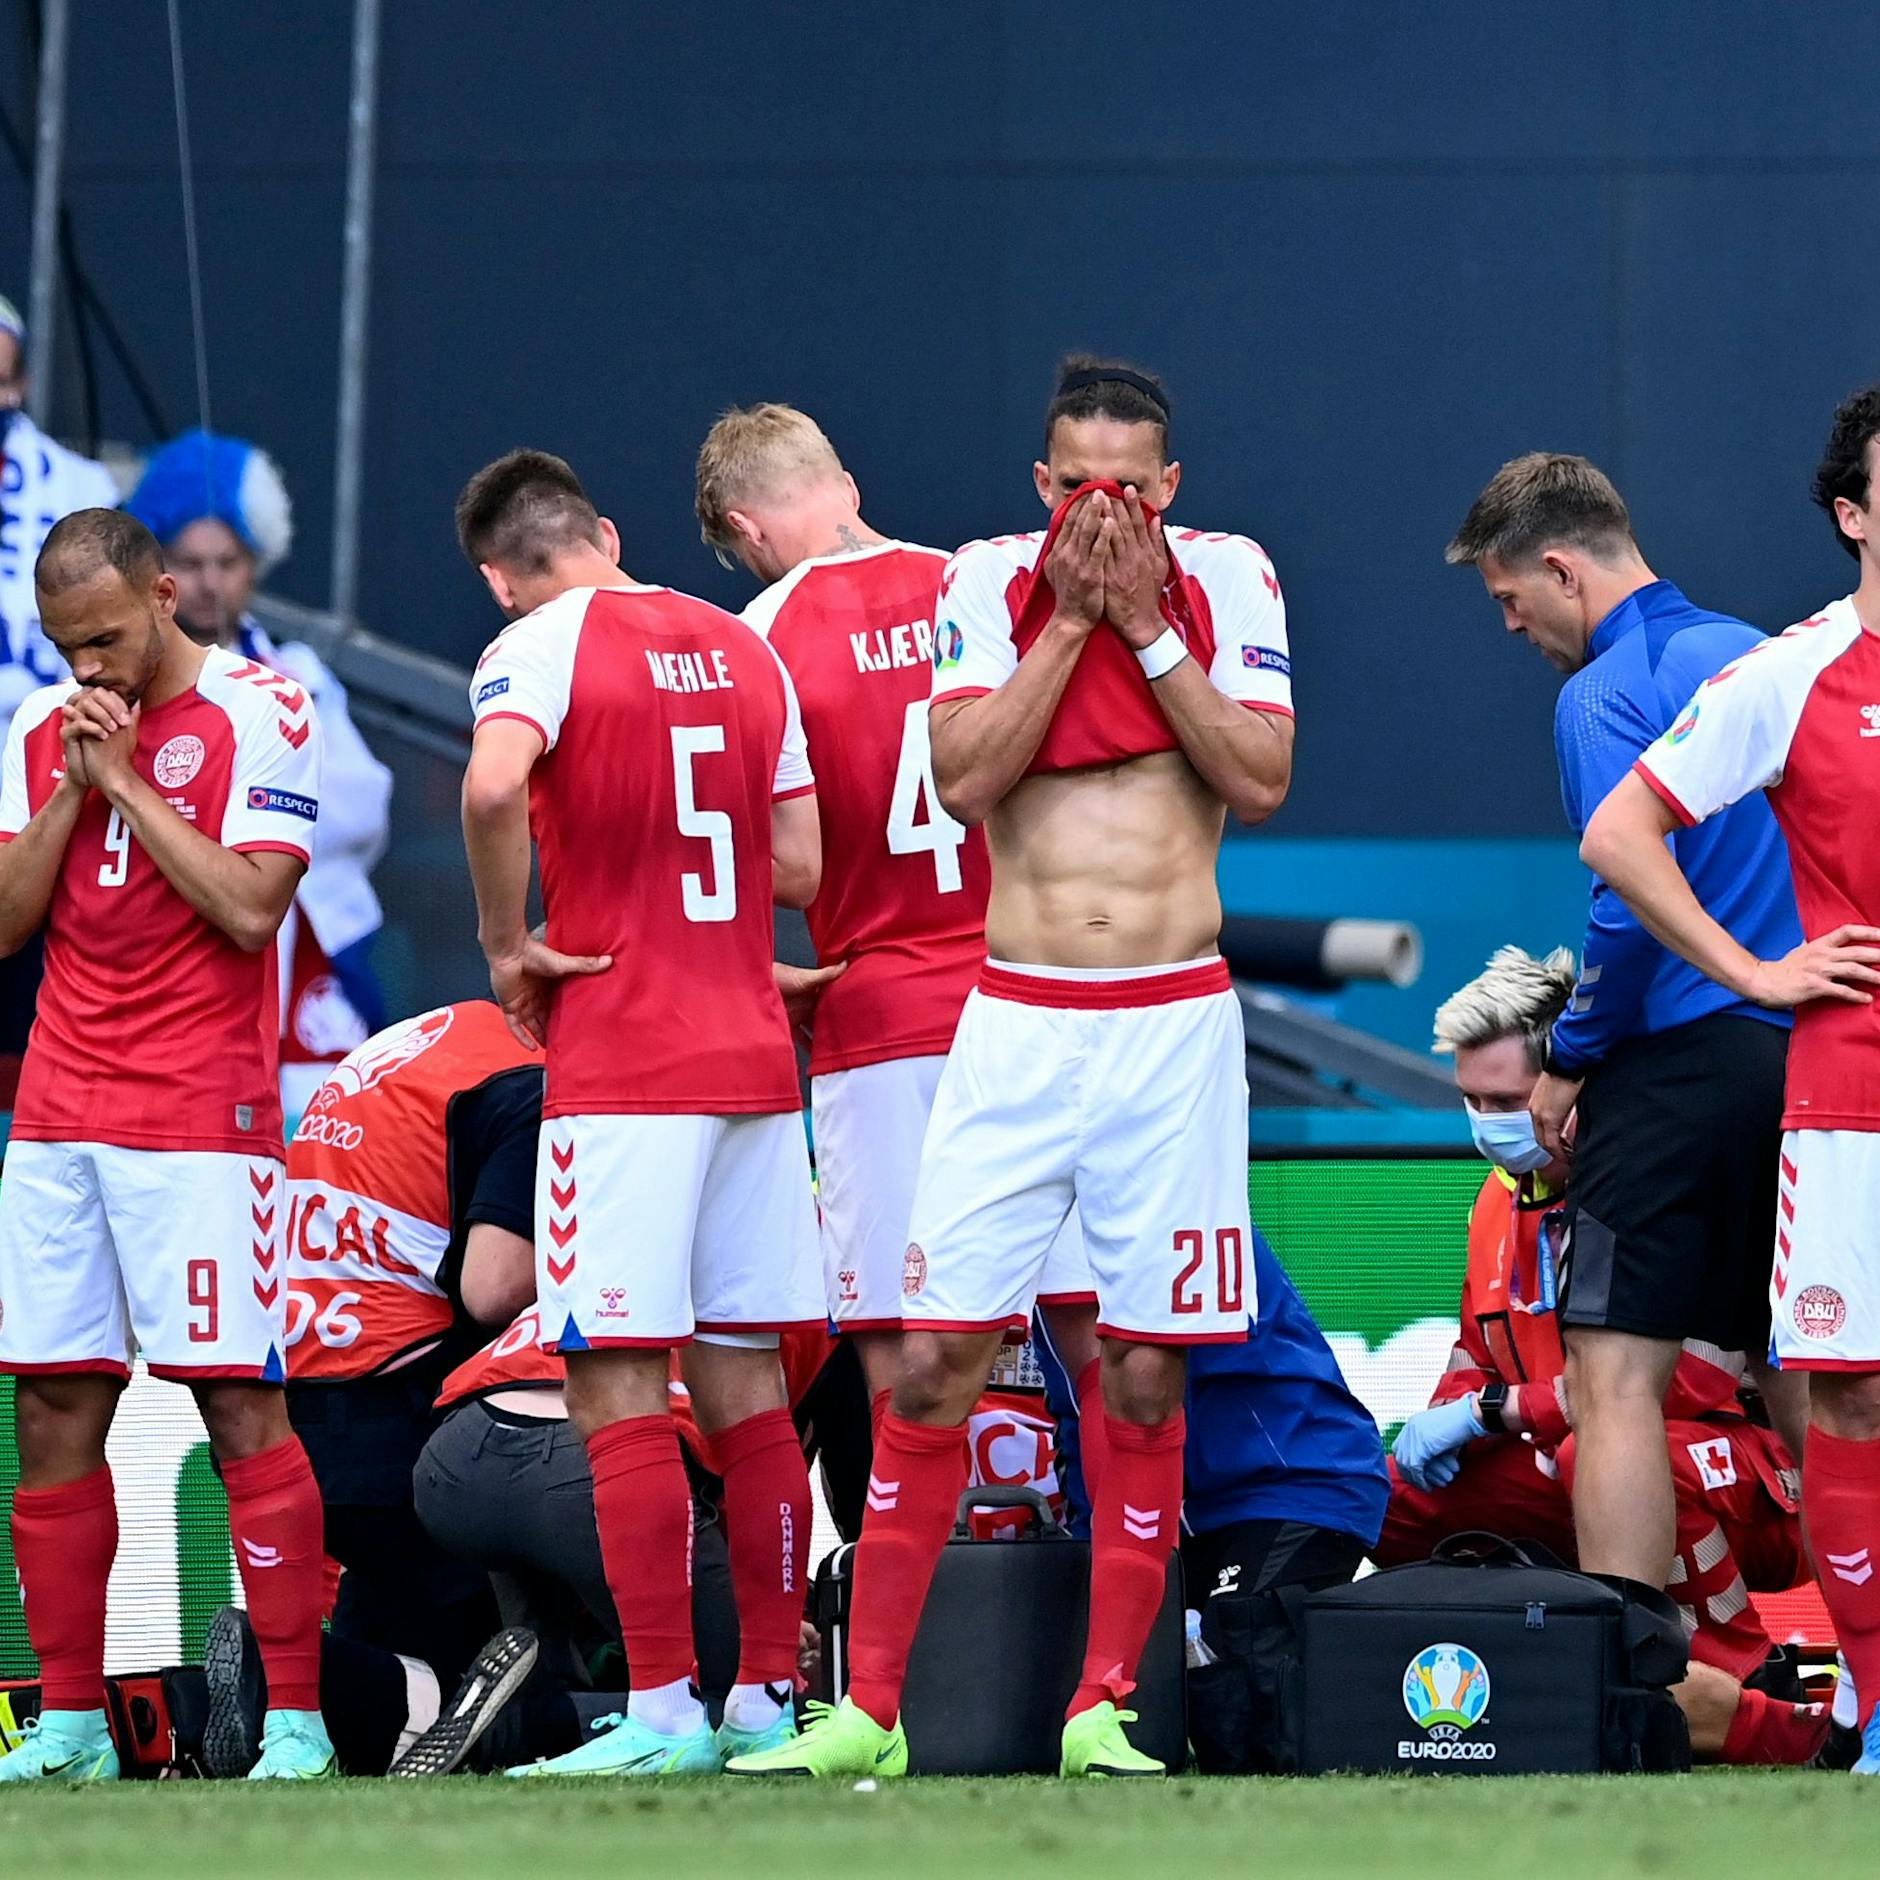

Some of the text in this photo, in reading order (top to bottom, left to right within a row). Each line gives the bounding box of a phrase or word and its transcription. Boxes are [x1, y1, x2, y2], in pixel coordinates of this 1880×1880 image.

[644, 649, 735, 693] MÆHLE
[849, 618, 934, 673] KJÆR
[269, 794, 317, 816] RESPECT
[669, 724, 737, 923] 5
[886, 697, 967, 894] 4
[97, 805, 131, 887] 9
[187, 1259, 218, 1343] 9
[1170, 1227, 1243, 1314] 20
[1803, 1302, 1836, 1319] DBU
[780, 1503, 793, 1593] DANMARK
[1398, 1741, 1496, 1760] EURO2020
